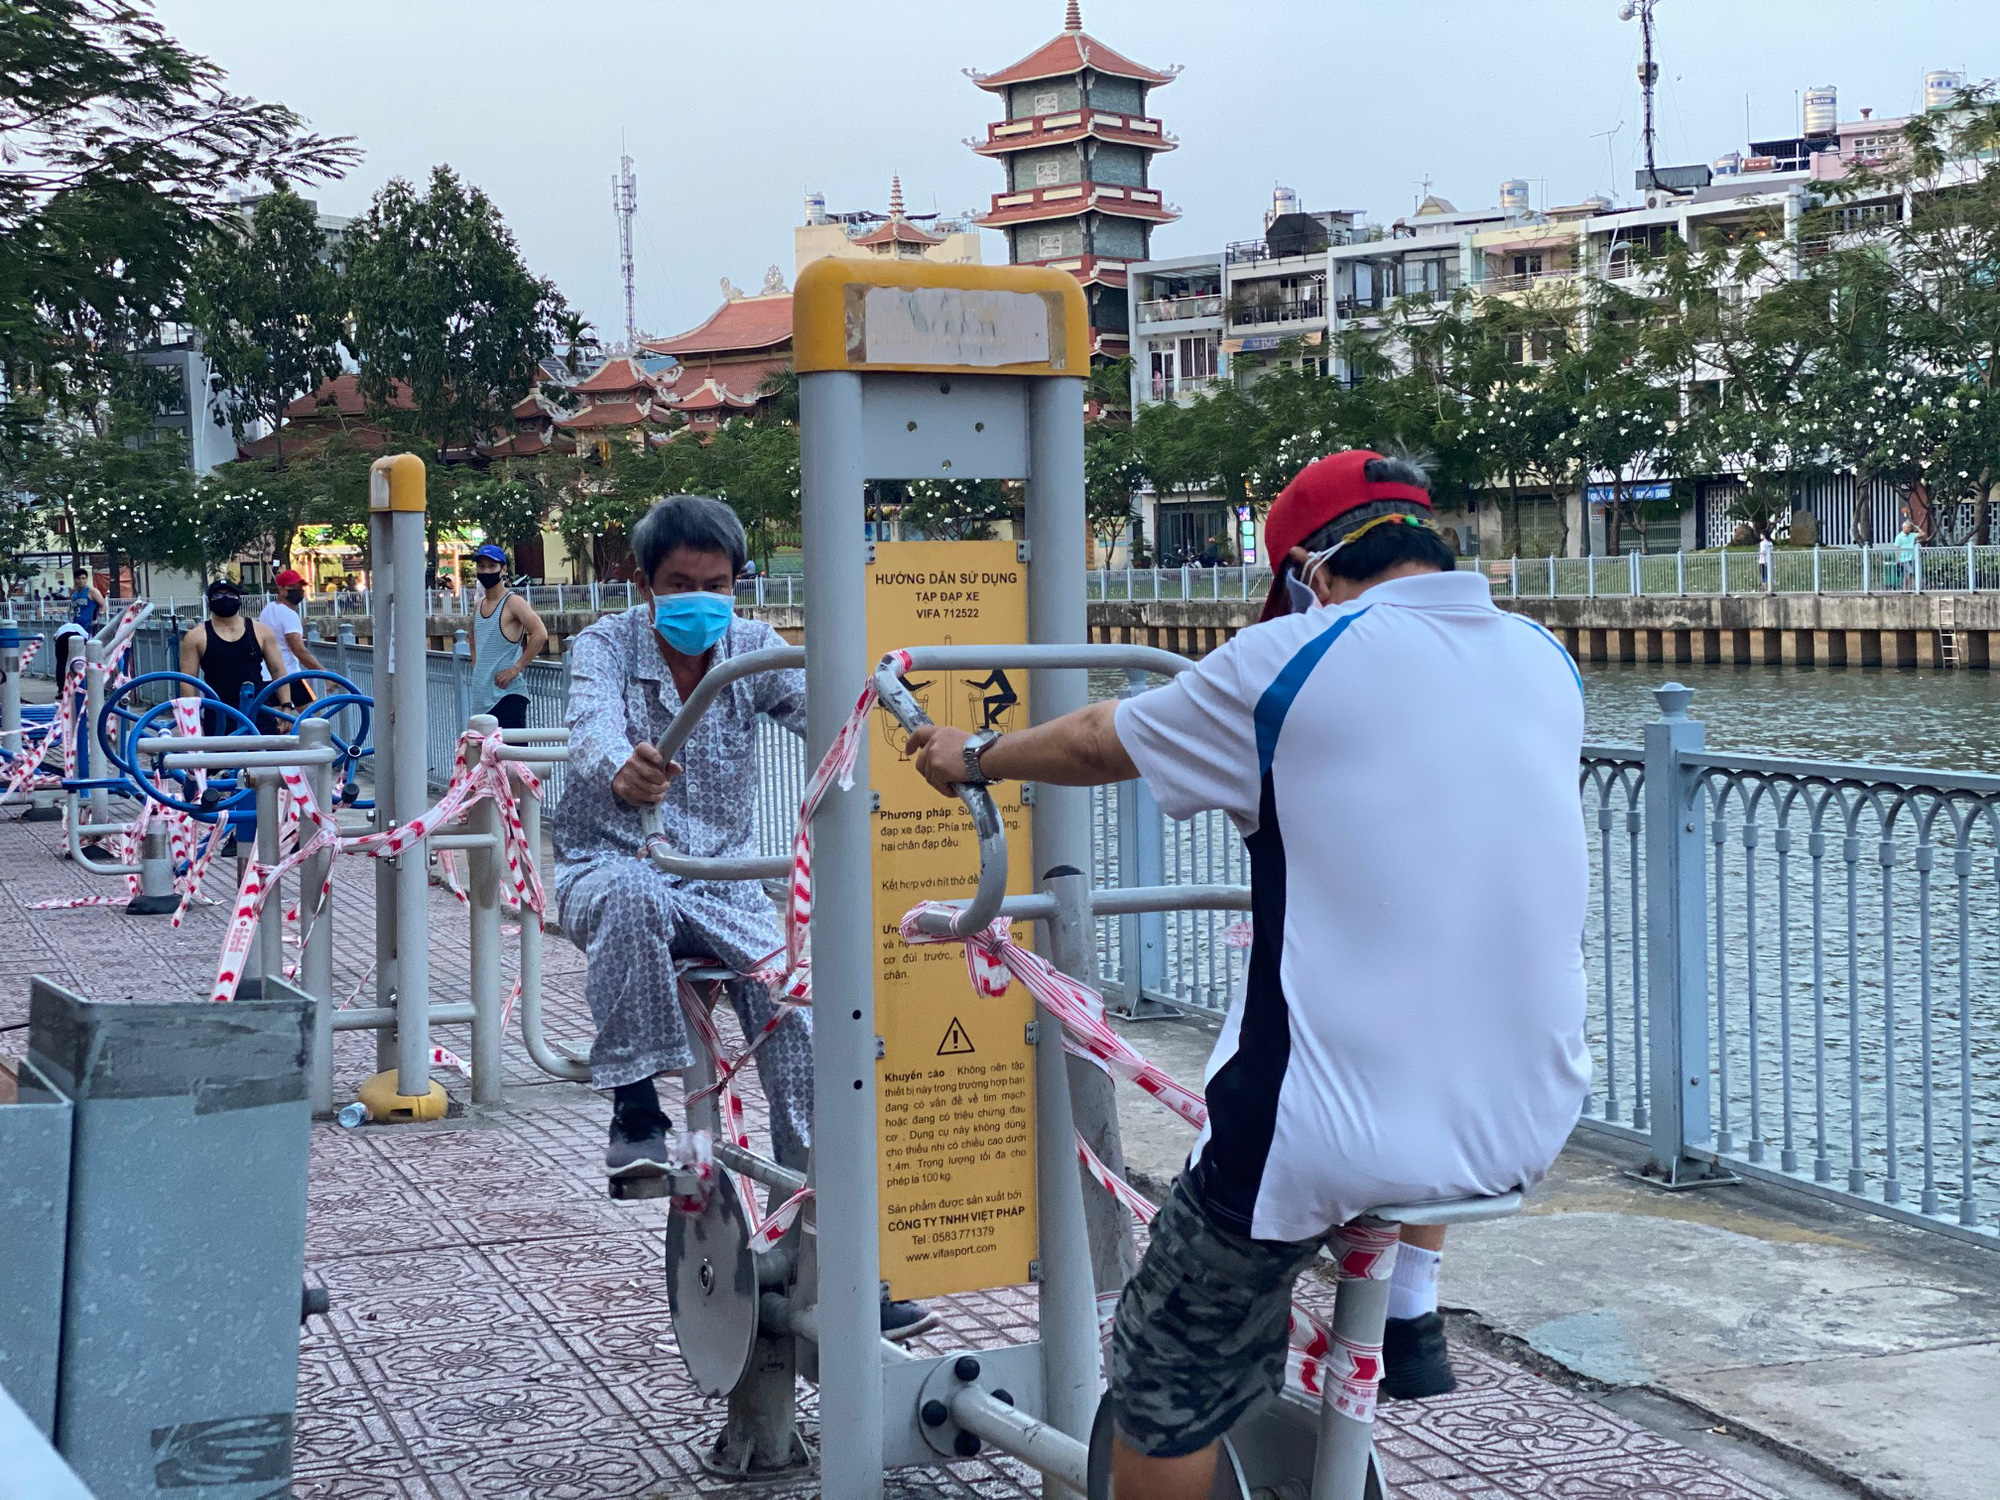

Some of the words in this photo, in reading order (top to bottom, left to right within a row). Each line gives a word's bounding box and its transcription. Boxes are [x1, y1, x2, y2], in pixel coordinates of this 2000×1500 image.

[876, 571, 925, 584] HƯỚNG
[930, 571, 956, 584] DẪN
[960, 571, 978, 584] SỬ
[982, 572, 1017, 586] DỤNG
[916, 591, 936, 604] TẬP
[940, 592, 962, 604] ĐẠP
[966, 592, 979, 601] XE
[917, 609, 940, 618] VIFA
[944, 608, 979, 618] 712522
[880, 810, 922, 820] Phương
[1002, 804, 1020, 813] như
[881, 826, 898, 838] đạp
[938, 823, 959, 832] Phía
[882, 843, 895, 851] hai
[898, 841, 920, 850] chân
[922, 839, 939, 850] đạp
[882, 879, 898, 890] Kết
[922, 878, 936, 888] với
[938, 878, 949, 886] hít
[951, 875, 965, 885] thở
[968, 874, 980, 884] đề
[883, 940, 894, 949] và
[884, 956, 896, 964] cơ
[903, 954, 917, 963] đùi
[885, 1069, 922, 1083] Khuyến
[928, 1069, 944, 1078] cáo
[958, 1065, 986, 1076] Không
[1012, 1061, 1025, 1071] tập
[885, 1087, 904, 1097] thiết
[916, 1085, 932, 1096] này
[934, 1083, 957, 1093] trong
[990, 1078, 1007, 1088] hợp
[886, 1102, 908, 1113] đang
[914, 1099, 924, 1109] có
[984, 1094, 996, 1102] tim
[1002, 1090, 1025, 1101] mạch
[912, 1113, 935, 1125] đang
[940, 1112, 950, 1122] có
[1010, 1105, 1026, 1114] đau
[886, 1134, 898, 1142] cơ
[910, 1129, 934, 1141] Dụng
[953, 1126, 969, 1136] này
[974, 1120, 1000, 1134] không
[1004, 1119, 1026, 1130] dùng
[886, 1147, 903, 1157] cho
[906, 1143, 928, 1155] thiếu
[931, 1142, 944, 1152] nhi
[948, 1141, 958, 1150] có
[988, 1136, 1003, 1145] cao
[1006, 1134, 1026, 1142] dưới
[918, 1158, 944, 1169] Trọng
[948, 1154, 975, 1165] lượng
[995, 1151, 1006, 1159] đa
[1011, 1148, 1026, 1158] cho
[887, 1176, 910, 1188] phép
[922, 1172, 938, 1182] 100
[888, 1202, 906, 1214] Sản
[939, 1198, 964, 1208] được
[888, 1217, 921, 1232] CÔNG
[924, 1217, 937, 1227] TY
[940, 1213, 968, 1225] TNHH
[971, 1208, 994, 1222] VIỆT
[996, 1204, 1025, 1218] PHÁP
[932, 1230, 956, 1243] 0583
[959, 1226, 994, 1240] 771379
[906, 1242, 996, 1263] www.vifasport.com
